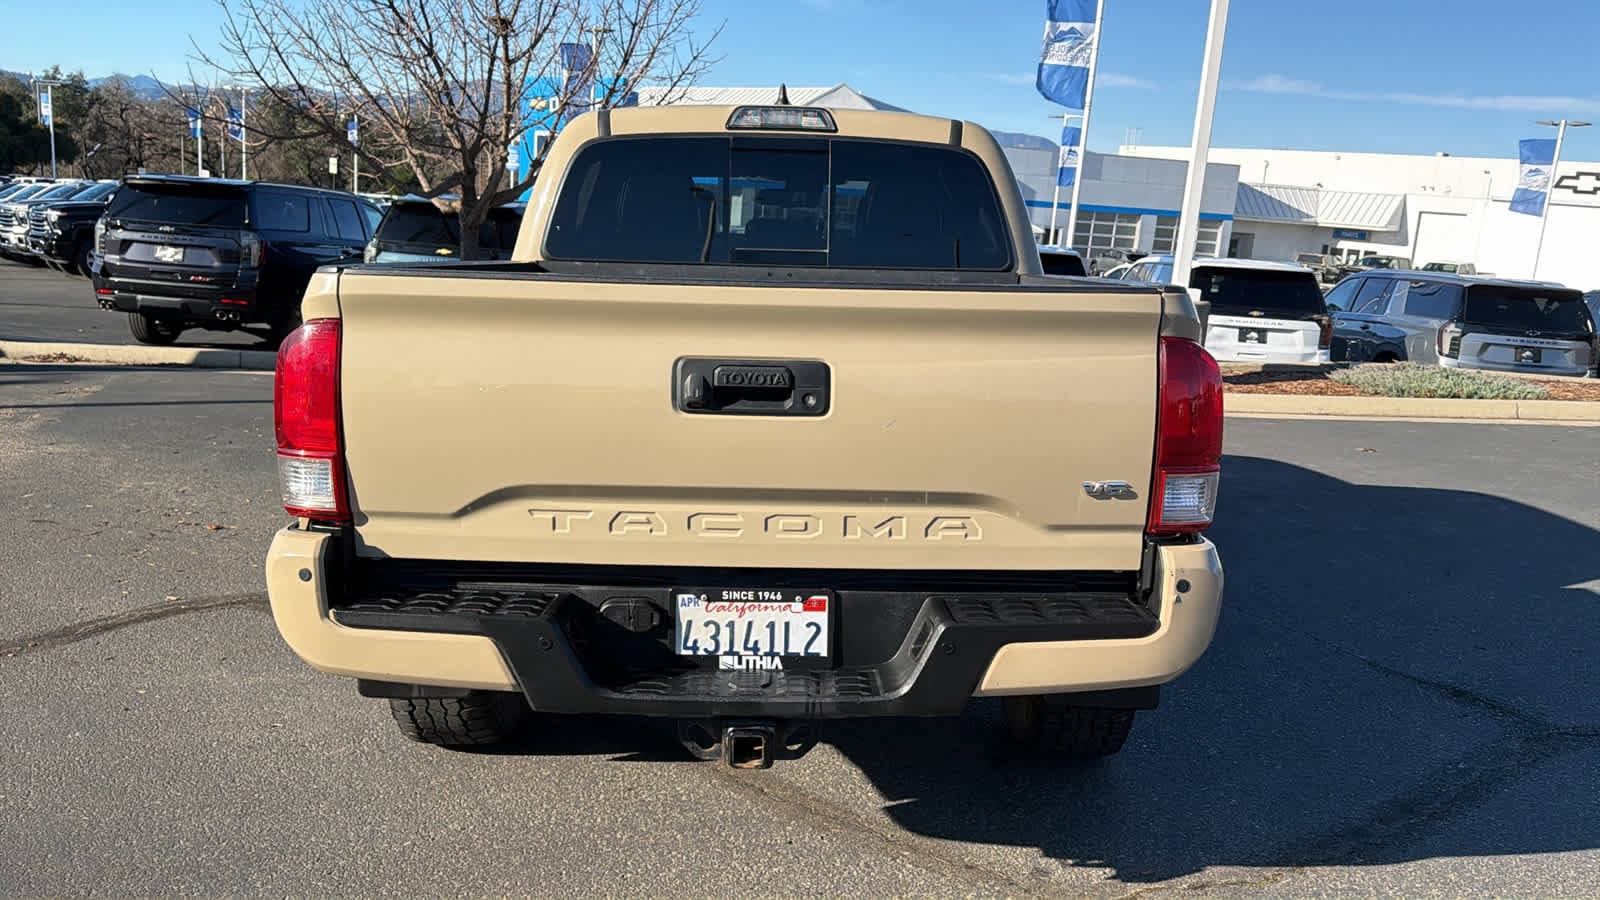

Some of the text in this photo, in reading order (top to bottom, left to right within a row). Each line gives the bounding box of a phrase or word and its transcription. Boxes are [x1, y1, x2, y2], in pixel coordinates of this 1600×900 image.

[720, 373, 786, 386] TOYOTA
[527, 508, 983, 541] TACOMA
[680, 597, 700, 607] APR
[721, 591, 782, 600] SINCE 1946
[704, 601, 800, 619] California
[682, 620, 822, 656] 43141L2
[733, 656, 783, 670] LITHIA
